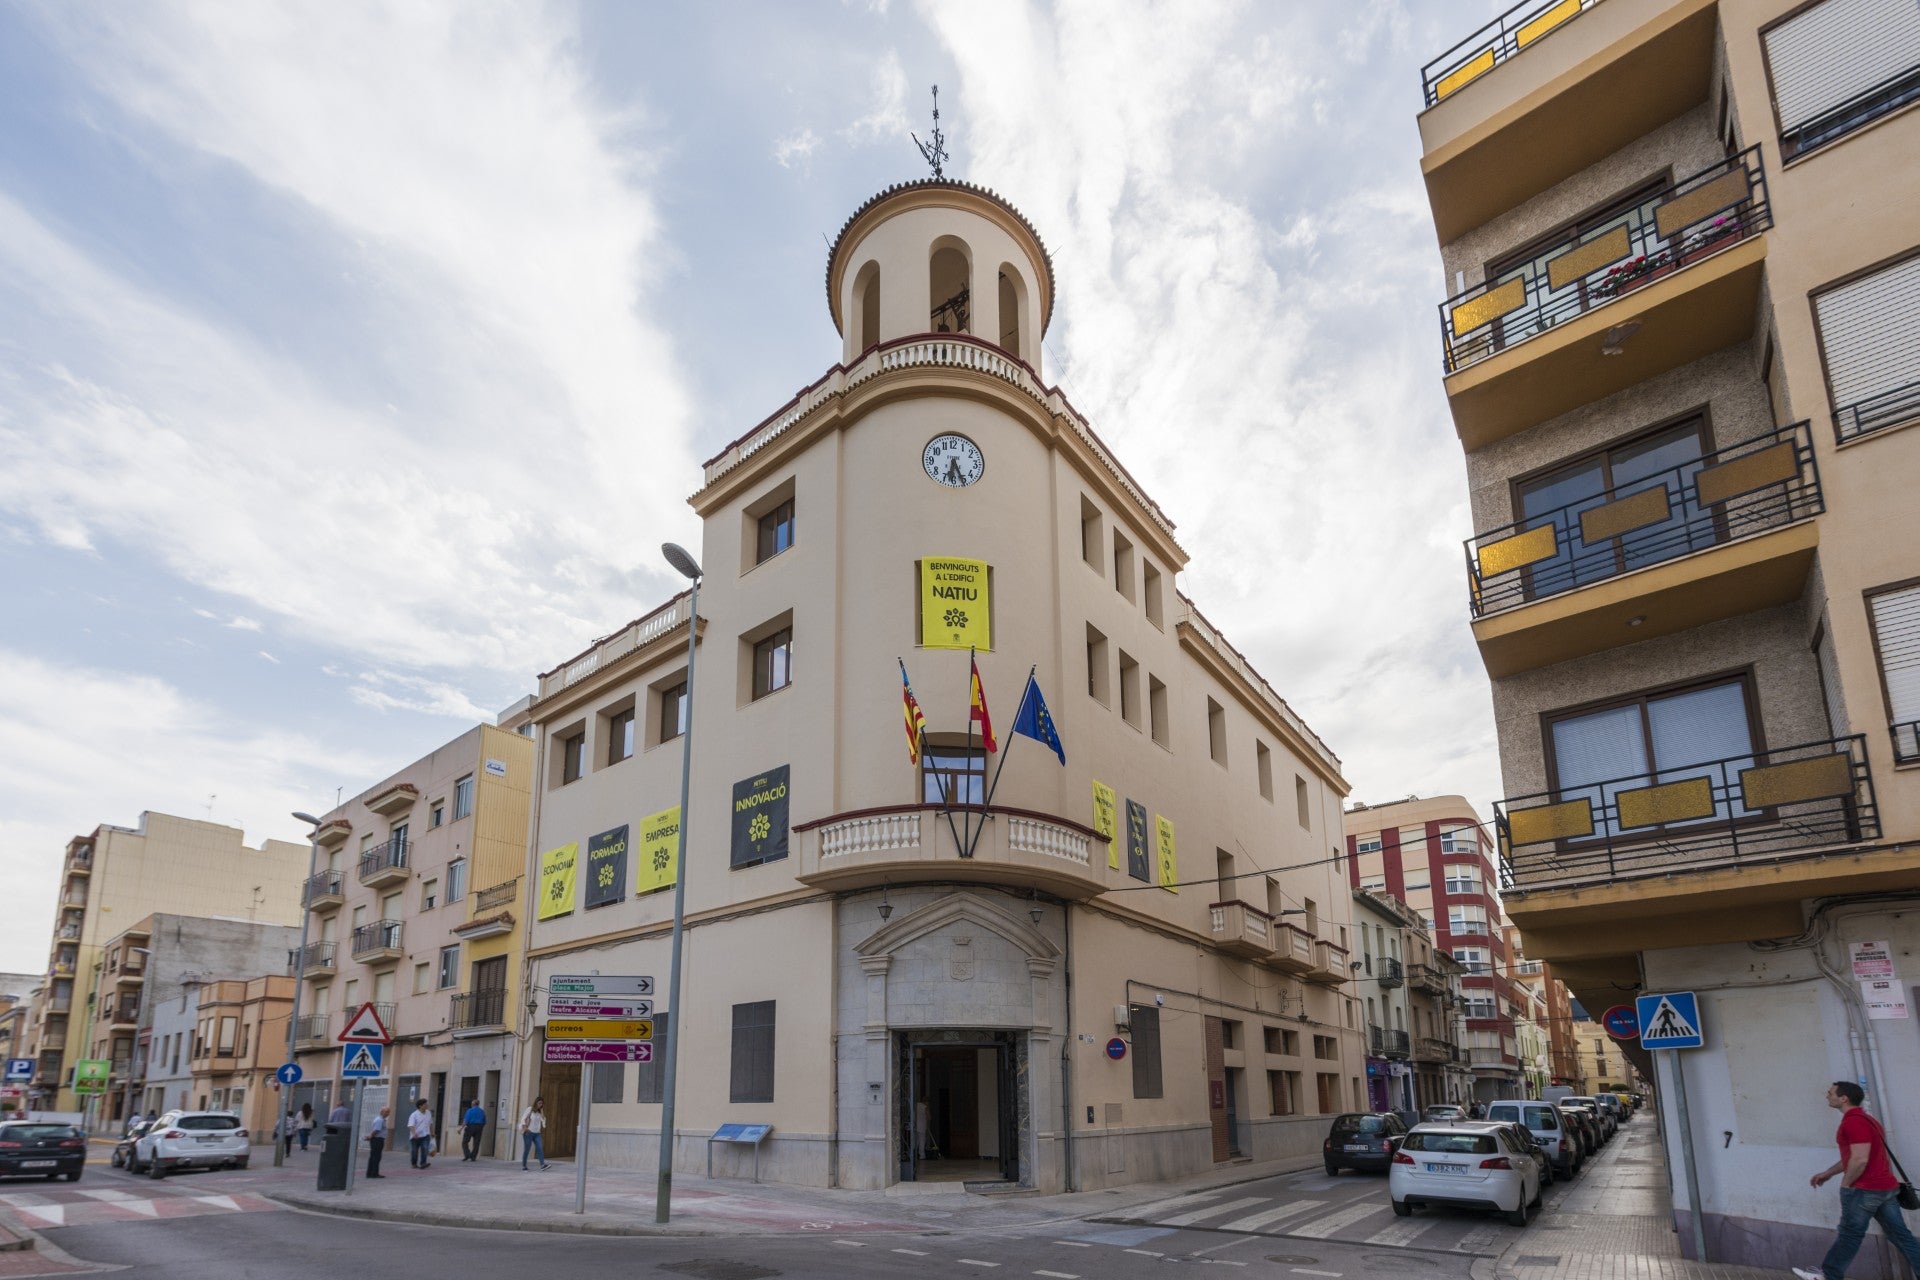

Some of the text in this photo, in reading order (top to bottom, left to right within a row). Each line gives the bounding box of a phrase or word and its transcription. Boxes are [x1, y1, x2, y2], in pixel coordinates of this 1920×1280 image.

[942, 442, 947, 450] 11
[950, 440, 957, 449] 12
[961, 443, 964, 452] 1
[933, 447, 941, 456] 10
[968, 449, 974, 458] 2
[929, 456, 934, 465] 9
[973, 460, 978, 469] 3
[933, 466, 939, 475] 8
[968, 469, 973, 478] 4
[942, 472, 948, 482] 7
[930, 562, 980, 573] BENVINGUTS
[935, 573, 975, 583] A L'EDIFICI
[932, 585, 978, 602] NATIU
[736, 782, 786, 812] INNOVACIÓ
[645, 823, 680, 843] EMPRESA
[590, 839, 625, 861] FORMACIÓ
